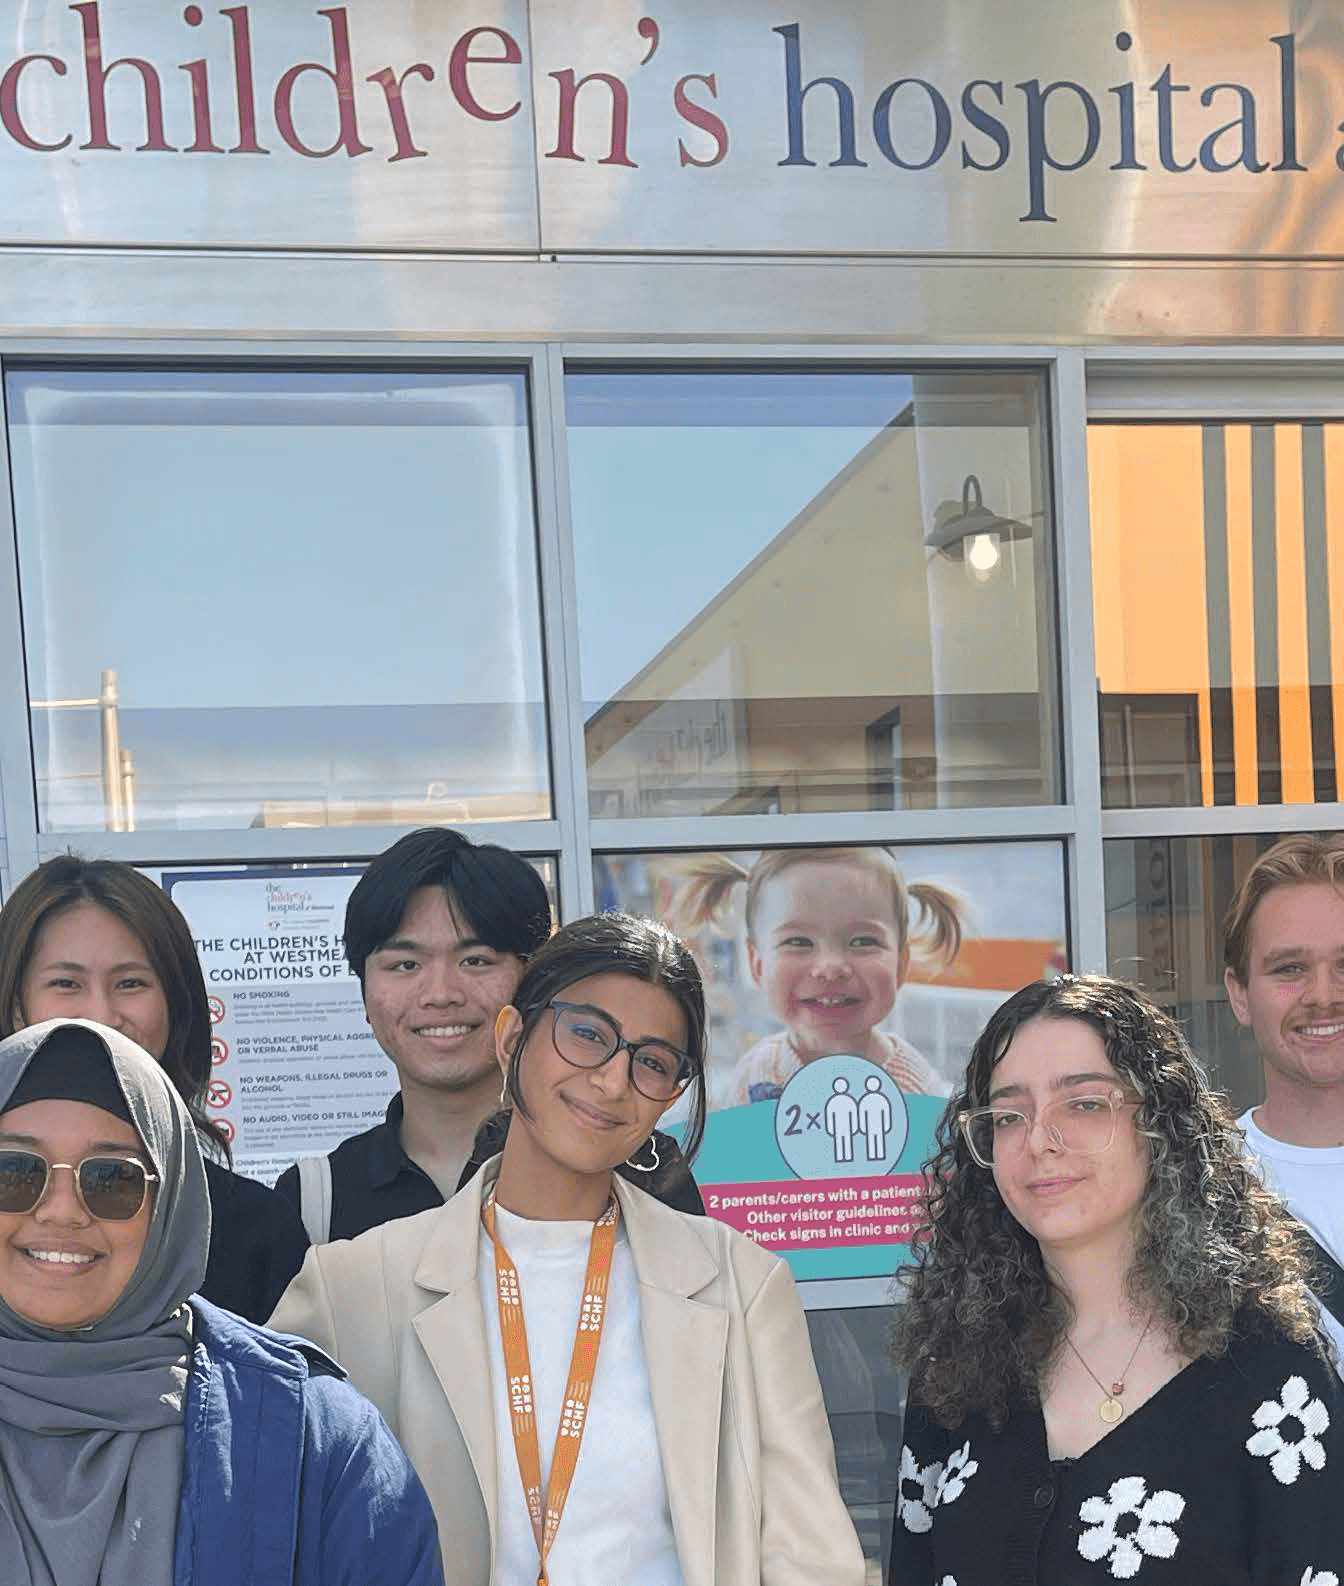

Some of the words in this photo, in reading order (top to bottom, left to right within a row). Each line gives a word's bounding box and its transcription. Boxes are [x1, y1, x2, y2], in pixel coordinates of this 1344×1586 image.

[772, 22, 1308, 222] hospital
[193, 938, 224, 952] THE
[230, 934, 329, 951] CHILDREN'S
[243, 951, 263, 965] AT
[270, 947, 346, 964] WESTME
[209, 965, 314, 982] CONDITIONS
[319, 964, 342, 977] OF
[362, 1109, 386, 1118] IMAG
[709, 1194, 719, 1208] 2
[721, 1191, 825, 1210] parents/carers
[827, 1187, 858, 1201] with
[860, 1189, 869, 1200] a
[872, 1185, 921, 1201] patient
[746, 1209, 787, 1225] Other
[790, 1207, 833, 1221] visitor
[835, 1203, 907, 1222] guidelines
[743, 1226, 786, 1242] Check
[789, 1226, 826, 1241] signs
[829, 1224, 842, 1238] in
[844, 1223, 882, 1237] clinic
[885, 1222, 910, 1235] and
[499, 1269, 512, 1305] SCHF
[589, 1294, 604, 1332] SCHF
[510, 1375, 524, 1413] SCHF
[570, 1400, 585, 1438] SCHF
